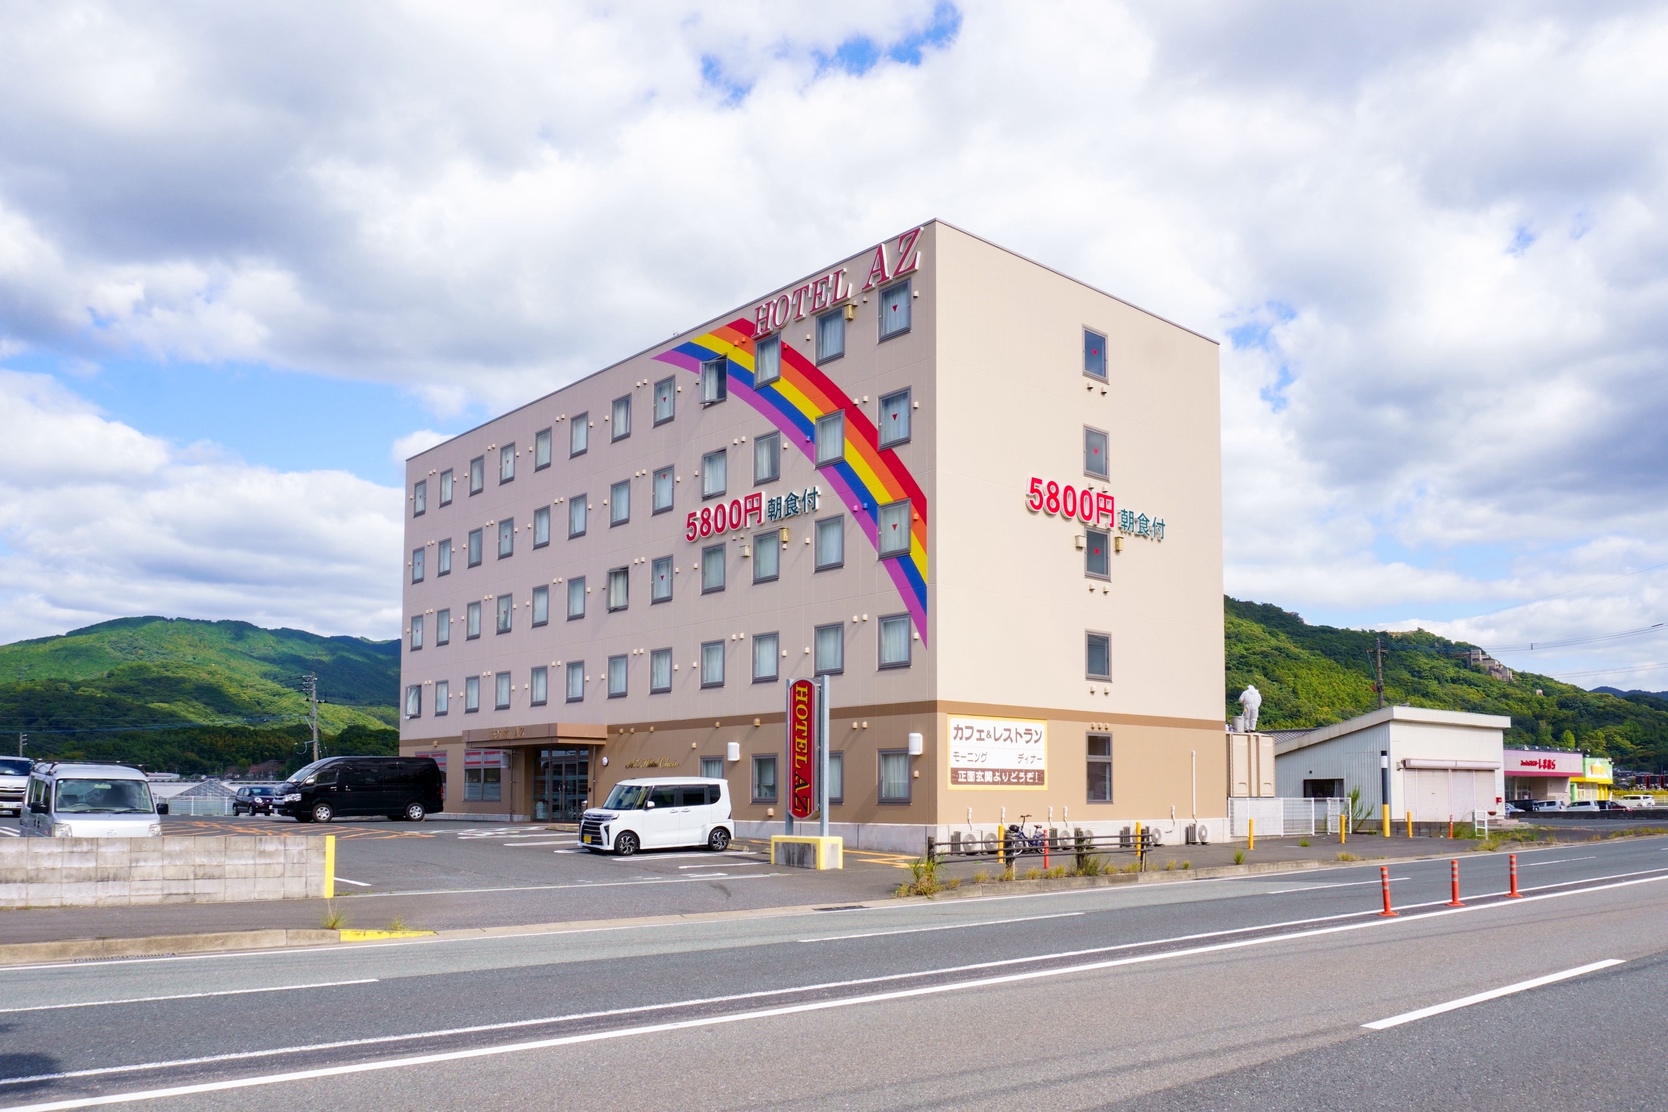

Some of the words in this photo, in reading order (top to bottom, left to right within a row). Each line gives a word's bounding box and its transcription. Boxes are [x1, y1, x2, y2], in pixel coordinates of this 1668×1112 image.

[751, 268, 853, 339] HOTEL
[862, 226, 924, 292] AZ
[685, 490, 765, 543] 5800円
[767, 486, 820, 522] 朝食付
[1026, 477, 1115, 529] 5800円
[1119, 508, 1166, 541] 朝食付
[795, 685, 808, 768] HOTEL
[953, 724, 1043, 744] カフェ&レストラン
[953, 751, 988, 763] モーニング
[1018, 753, 1043, 764] ディナー
[794, 770, 810, 814] AZ
